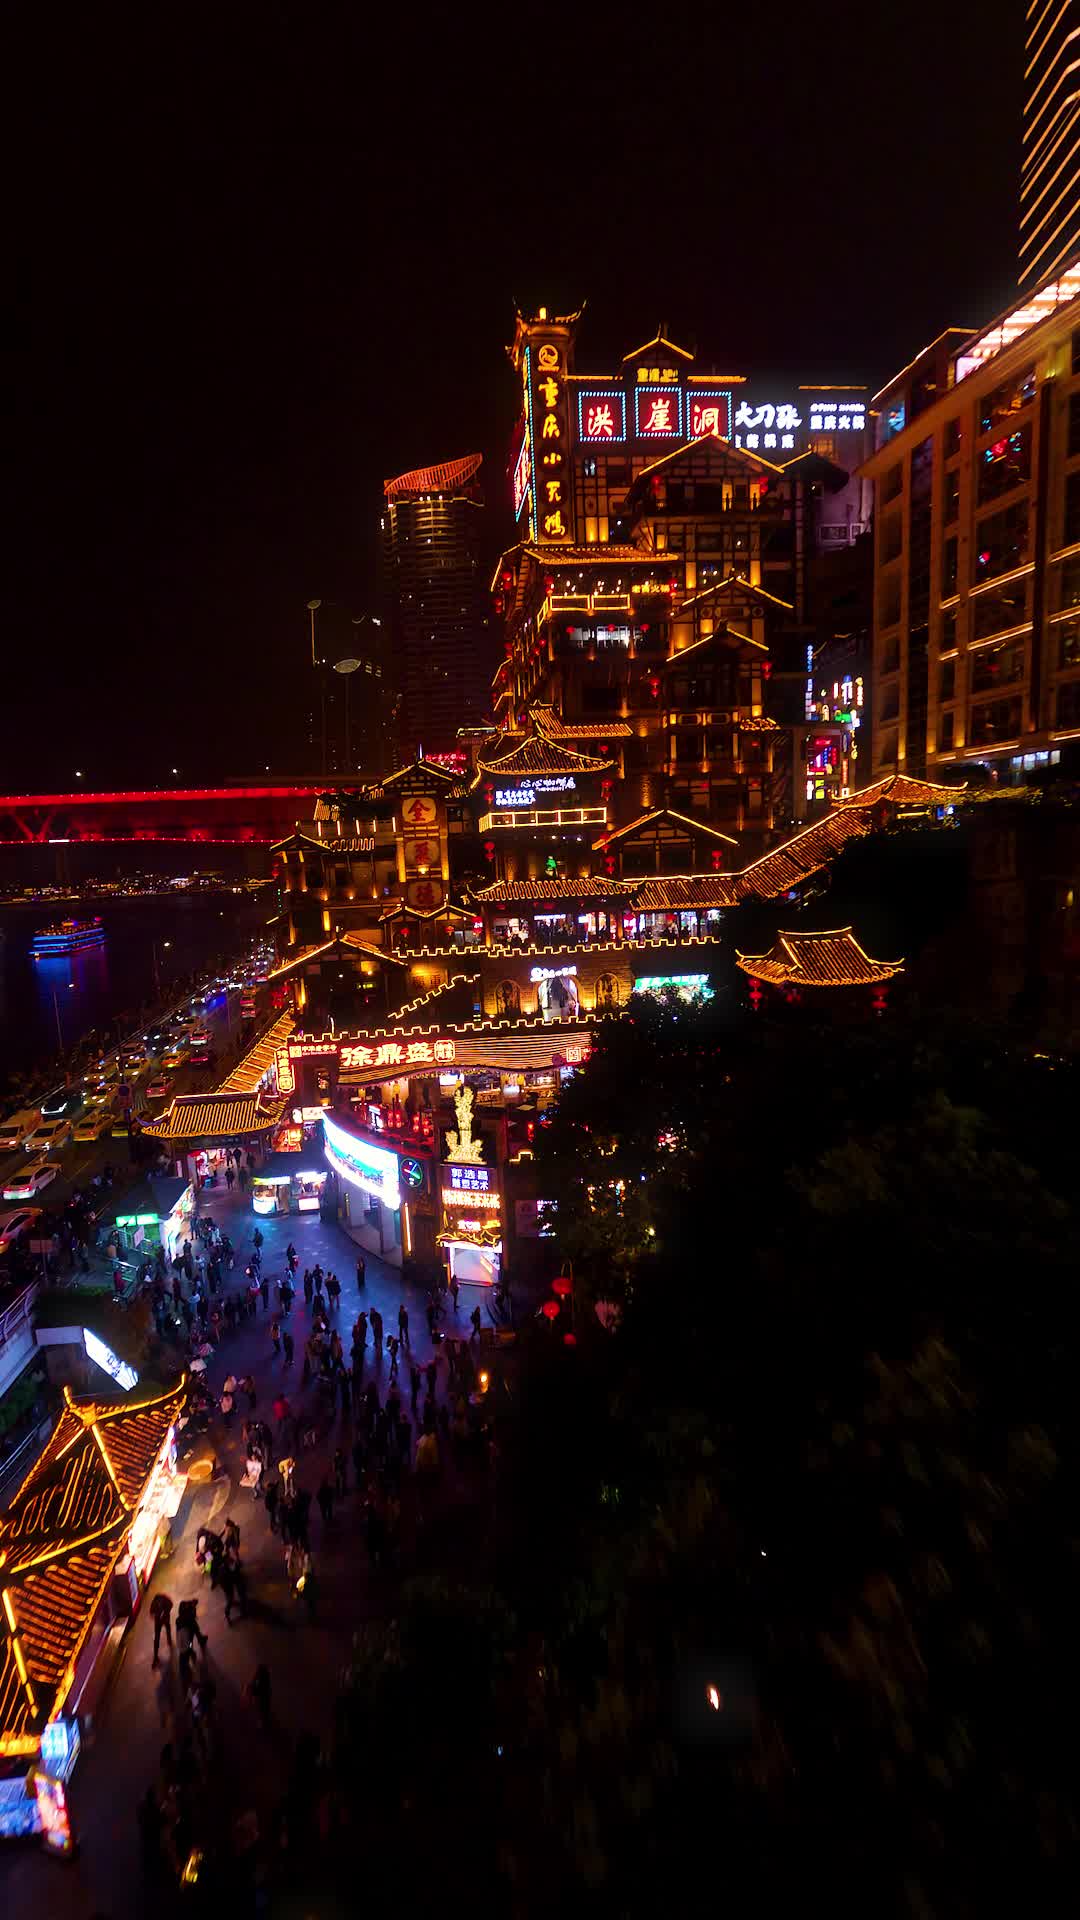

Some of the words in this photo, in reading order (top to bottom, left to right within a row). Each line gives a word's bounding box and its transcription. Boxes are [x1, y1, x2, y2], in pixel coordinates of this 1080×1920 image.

[587, 398, 720, 437] 洪崖洞
[538, 376, 566, 536] 重庆小天鹅
[340, 1041, 435, 1067] 徐鼎盛
